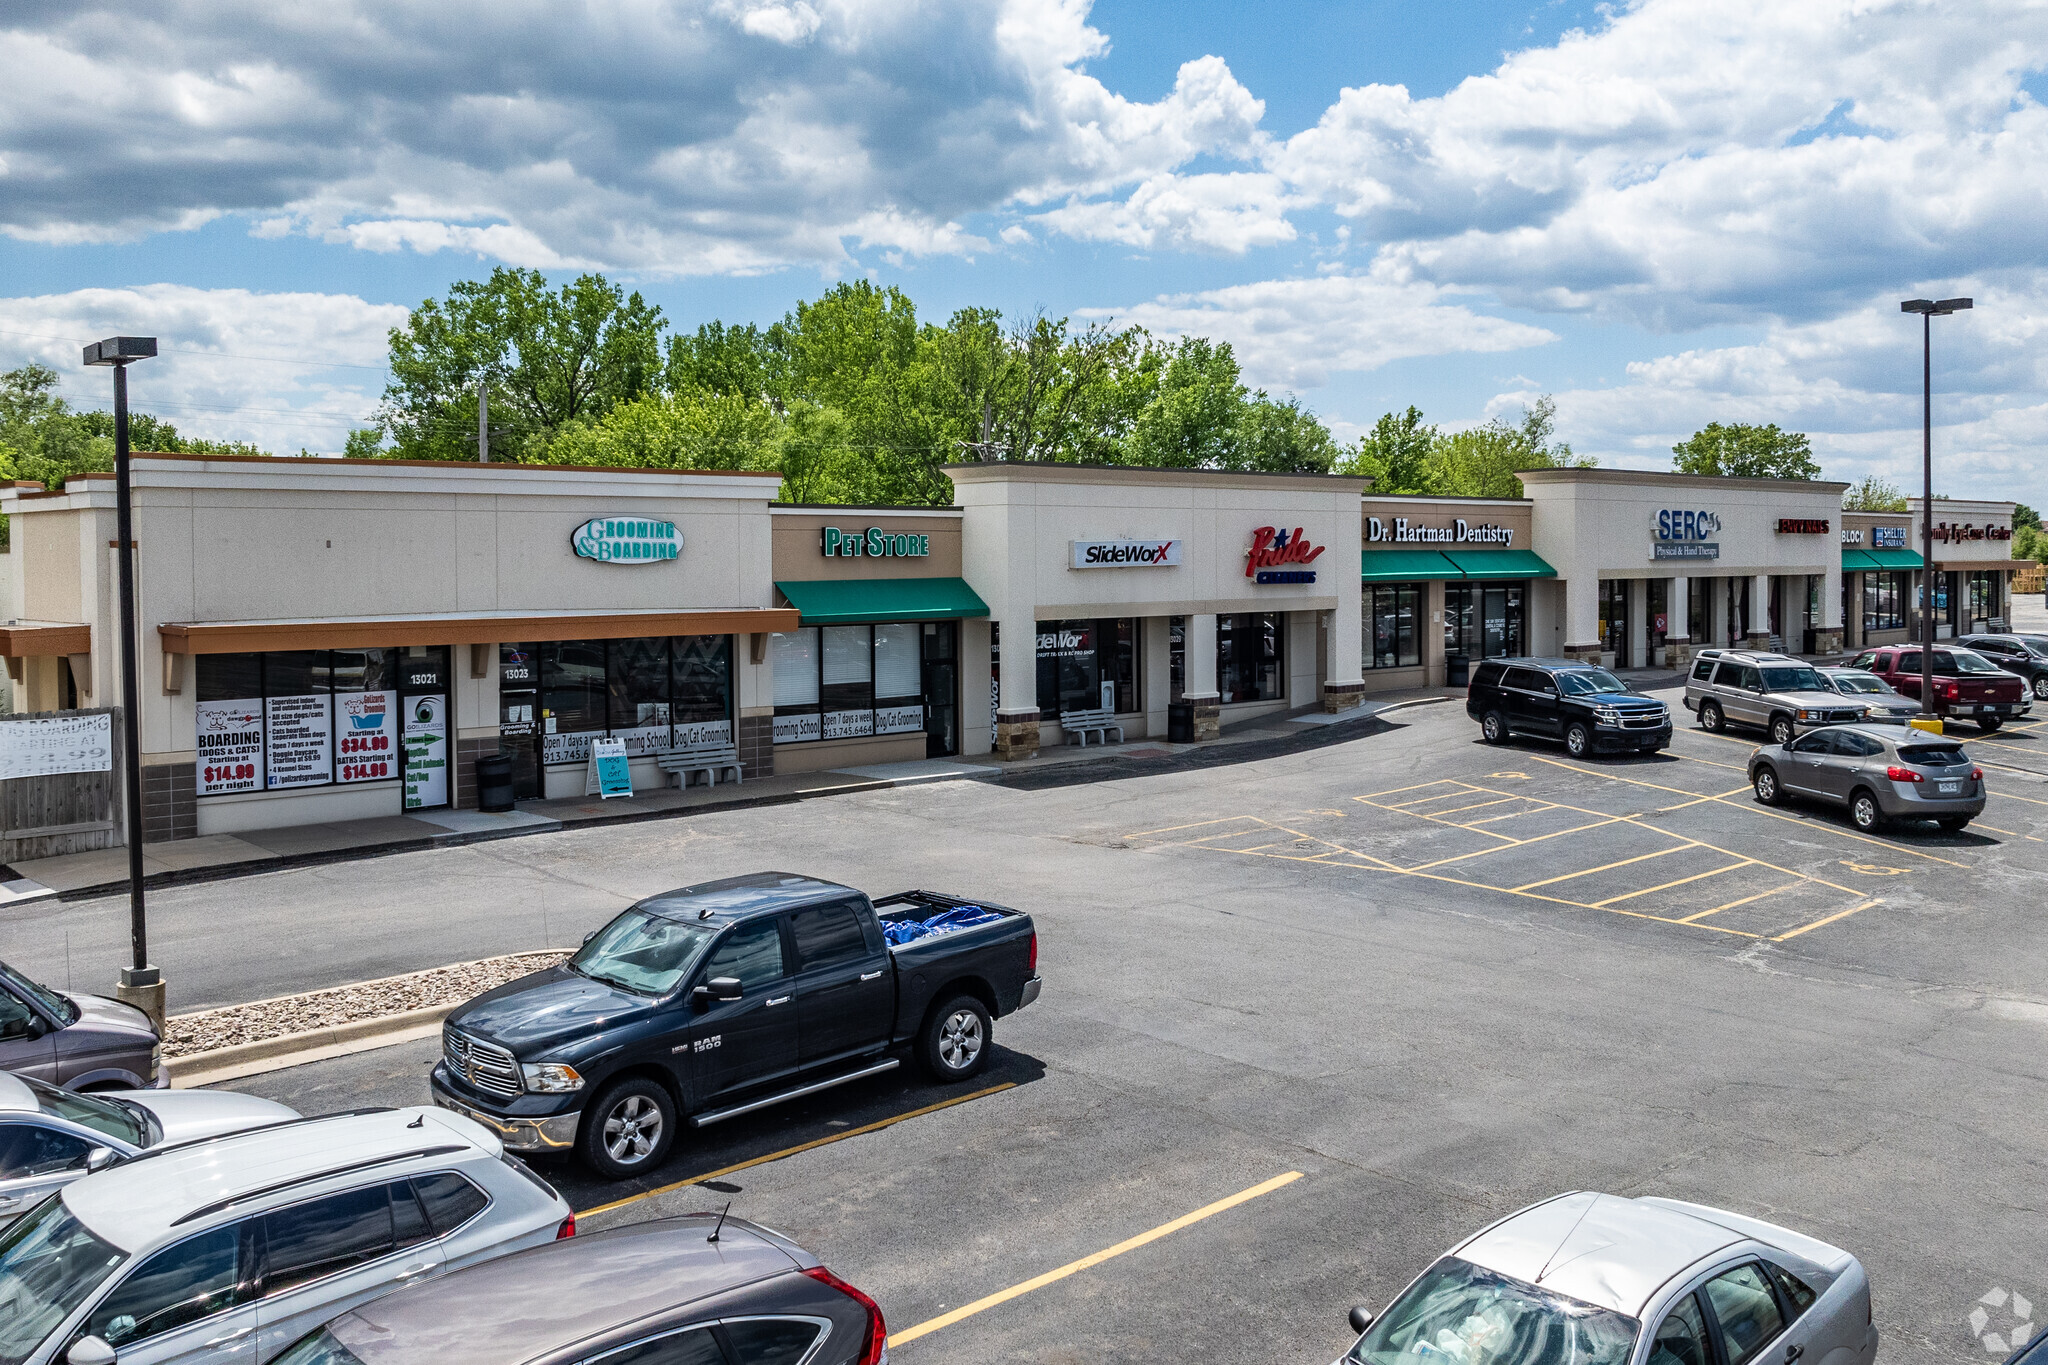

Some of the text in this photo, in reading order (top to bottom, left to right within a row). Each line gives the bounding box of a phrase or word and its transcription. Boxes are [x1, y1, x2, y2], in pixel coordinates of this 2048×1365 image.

[1368, 517, 1514, 547] Dr. Hartman Dentistry
[1657, 510, 1709, 540] SERC
[1780, 519, 1829, 534] ENVY NAILS
[1842, 530, 1864, 543] BLOCK
[1884, 528, 1906, 538] SHELTER
[824, 527, 929, 557] PET STORE
[1085, 542, 1172, 564] SlideWorX
[1246, 526, 1325, 577] Pride
[1656, 546, 1717, 558] Physical & Hand Therapy
[1036, 633, 1089, 650] deWorX
[411, 674, 437, 684] 13021
[505, 668, 528, 679] 13023
[364, 704, 386, 714] Grooming
[824, 714, 836, 726] Open
[838, 714, 841, 724] 7
[842, 713, 854, 725] days
[860, 712, 872, 722] week
[876, 710, 921, 731] Dog/Cat Grooming
[774, 718, 820, 738] rooming School
[824, 726, 872, 737] 913.745.6464
[198, 731, 260, 748] BOARDING
[544, 736, 560, 749] Open
[562, 735, 566, 747] 7
[568, 734, 582, 748] days
[585, 737, 588, 745] a
[646, 731, 670, 748] School
[675, 726, 729, 748] Dog/Cat Grooming
[341, 736, 388, 754] $34.99
[337, 756, 357, 765] BATHS
[359, 754, 385, 763] Starting
[423, 758, 445, 768] Animals
[544, 749, 590, 762] 913.745.6
[204, 764, 254, 783] $14.99
[343, 762, 387, 780] $14.99
[407, 772, 429, 782] Cat/Dog
[226, 781, 254, 789] night
[694, 1034, 721, 1047] RAM
[694, 1041, 721, 1053] 1500
